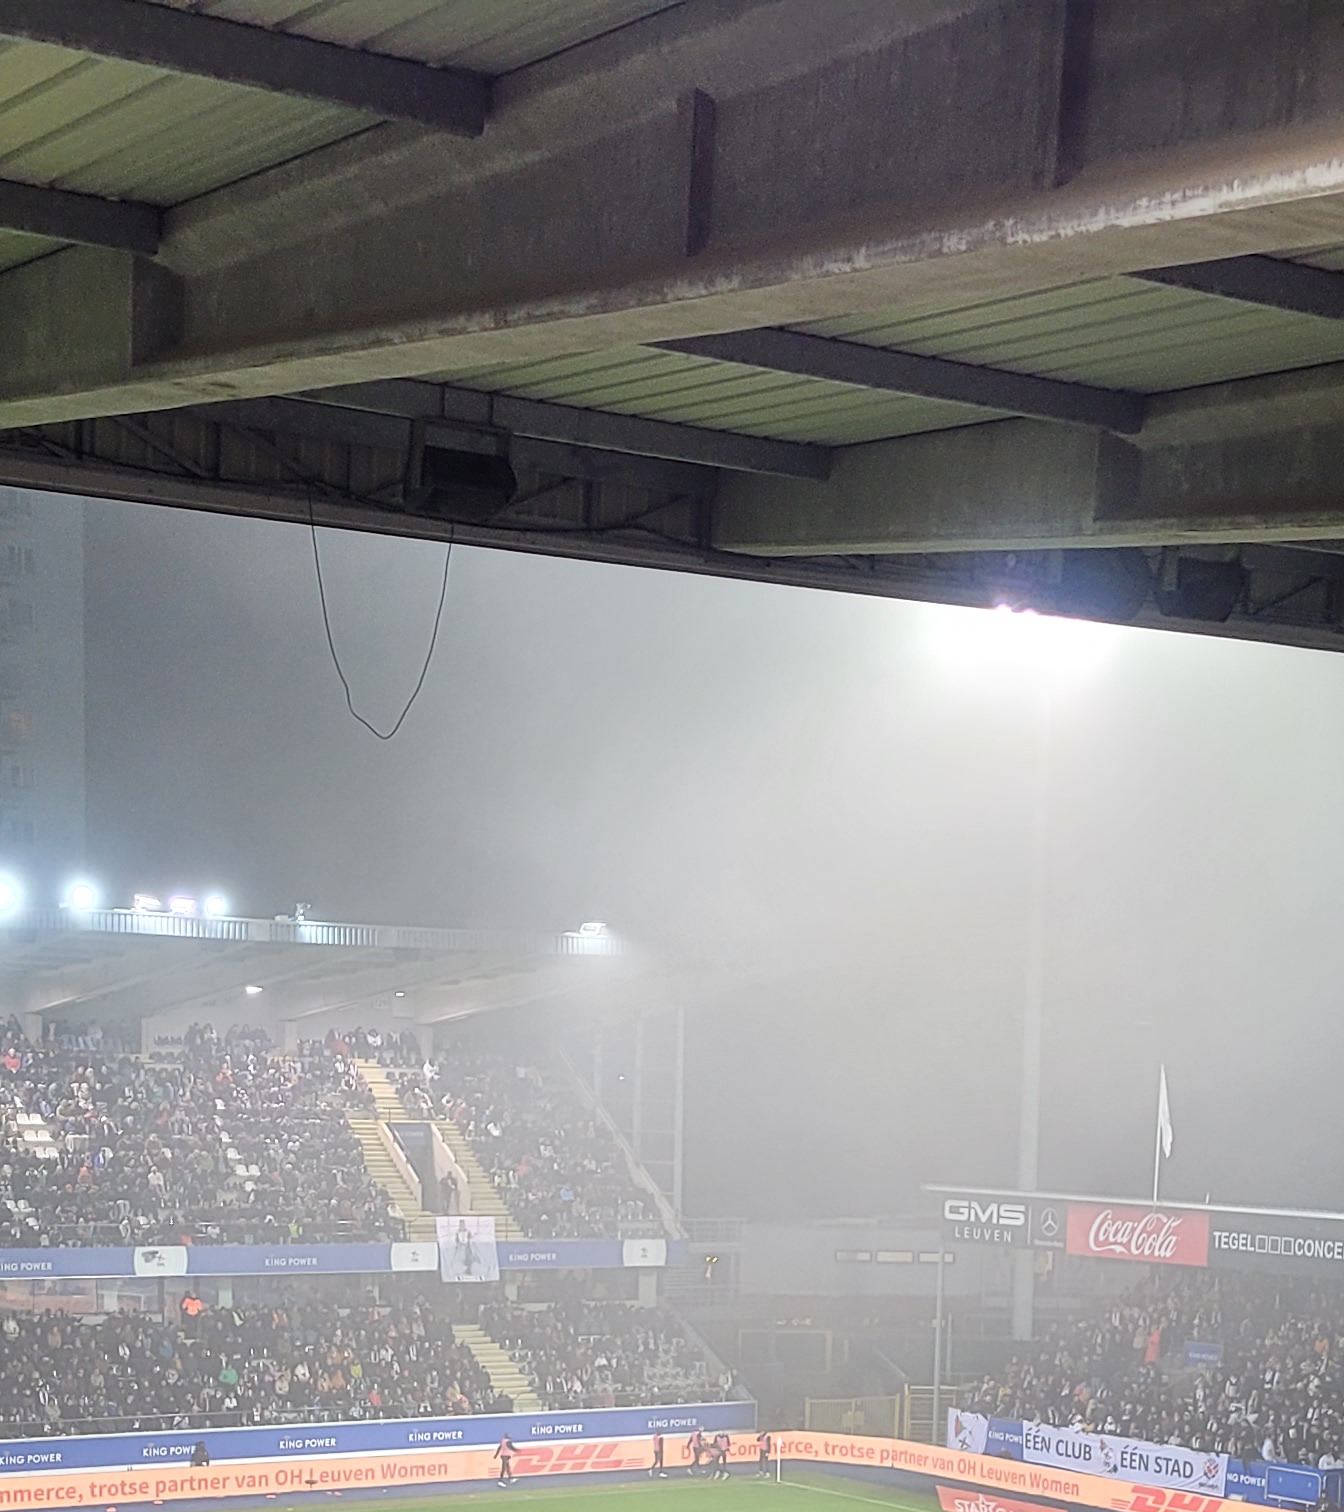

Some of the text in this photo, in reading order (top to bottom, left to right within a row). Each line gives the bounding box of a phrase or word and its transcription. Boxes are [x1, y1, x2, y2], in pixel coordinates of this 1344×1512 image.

[944, 1200, 1025, 1226] GMS
[955, 1226, 1012, 1242] LEUVEN
[1213, 1231, 1256, 1252] TEGEL
[20, 1262, 52, 1271] POWER
[265, 1257, 317, 1266] KING POWER
[531, 1423, 583, 1435] KING POWER
[648, 1418, 697, 1429] KING POWER
[409, 1430, 463, 1442] KING POWER
[1005, 1433, 1023, 1444] POWE
[279, 1437, 336, 1449] KING POWER
[142, 1444, 196, 1457] KING POWE
[1025, 1427, 1194, 1478] ÉÉN CLUB ÉÉN STAD
[27, 1453, 62, 1464] POWER
[512, 1443, 624, 1474] DHL
[824, 1441, 875, 1459] trotse
[880, 1444, 929, 1468] partner
[931, 1455, 954, 1472] van
[957, 1459, 976, 1477] OH
[980, 1462, 1026, 1486] Leuven
[1029, 1472, 1080, 1497] Women
[89, 1479, 150, 1498] trotse
[156, 1474, 230, 1502] partner
[237, 1471, 269, 1489] van
[274, 1467, 303, 1487] OH
[308, 1463, 376, 1484] Leuven
[380, 1461, 448, 1481] Women
